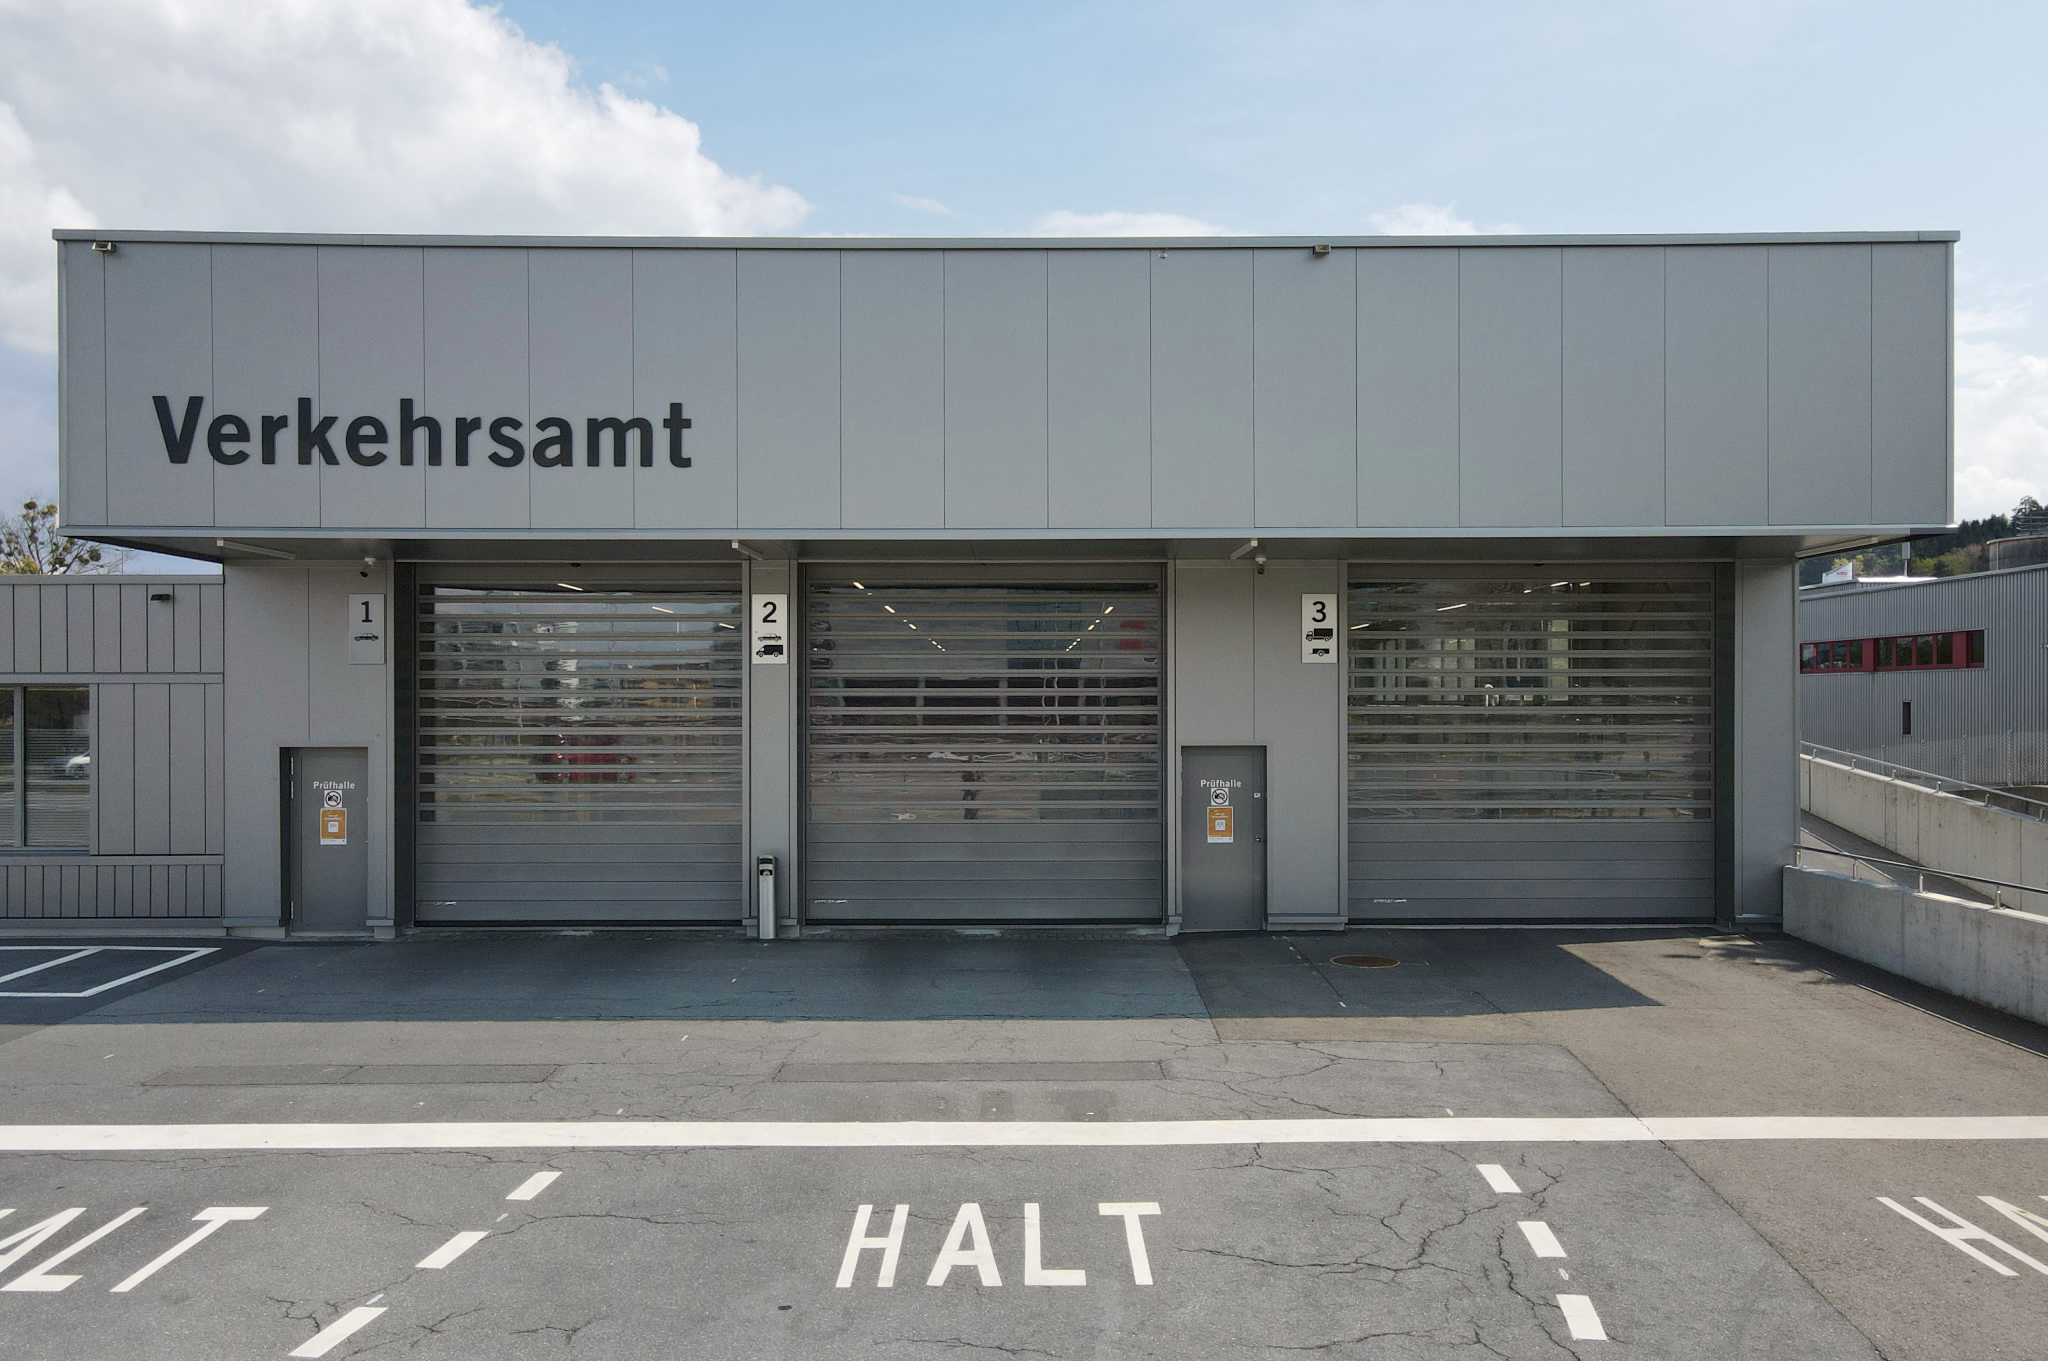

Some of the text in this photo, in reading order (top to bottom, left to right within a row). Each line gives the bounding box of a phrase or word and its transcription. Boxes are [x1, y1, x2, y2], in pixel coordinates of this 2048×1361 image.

[152, 395, 693, 469] Verkehrsamt
[361, 601, 372, 622] 1
[762, 601, 777, 623] 2
[1312, 601, 1326, 622] 3
[313, 781, 355, 789] Prüfhalle
[1200, 779, 1241, 787] Prüfhalle
[0, 1206, 270, 1293] ALT
[835, 1202, 1162, 1288] HALT
